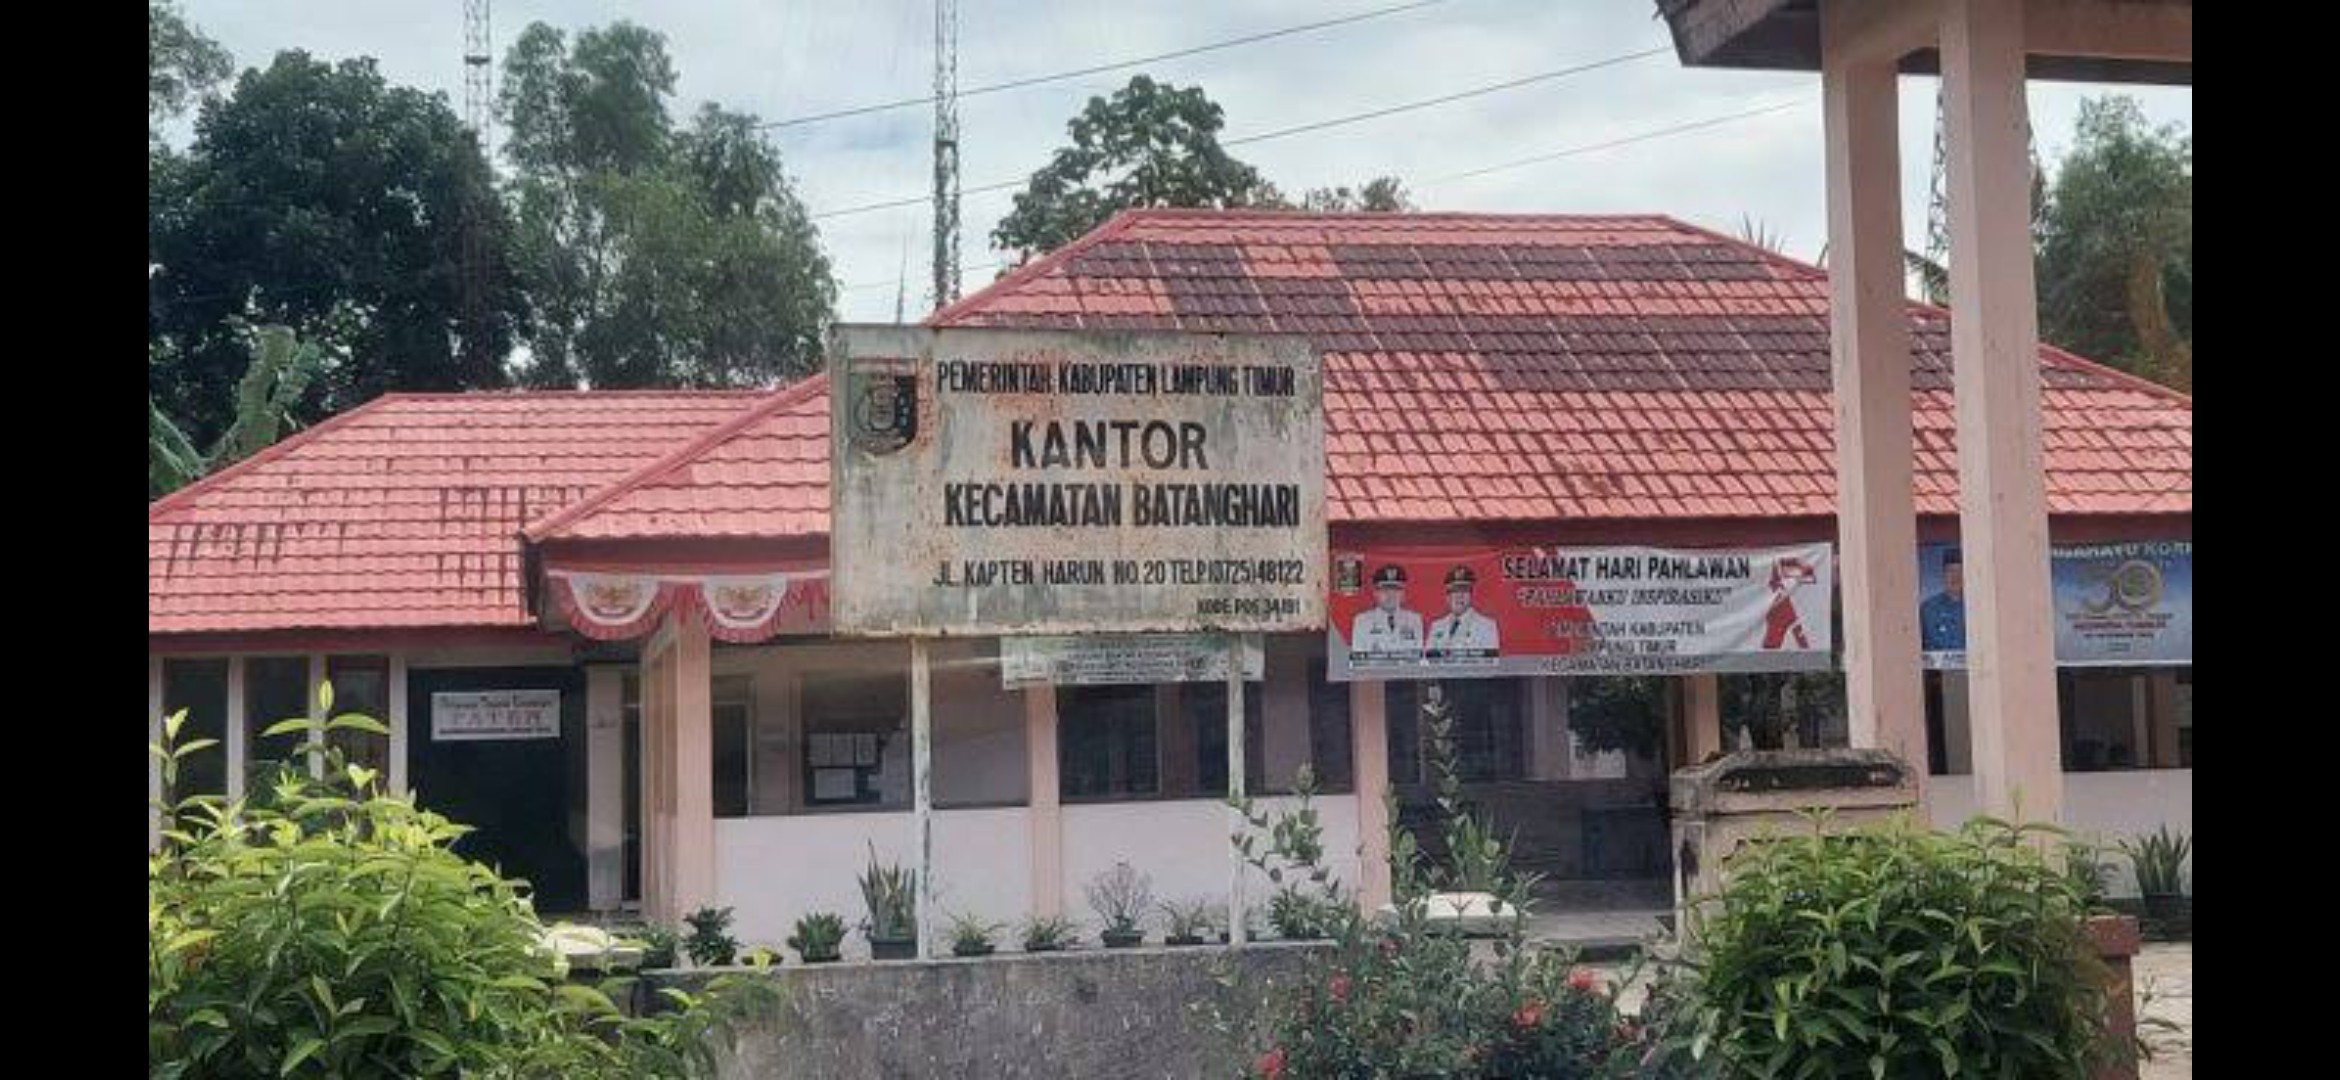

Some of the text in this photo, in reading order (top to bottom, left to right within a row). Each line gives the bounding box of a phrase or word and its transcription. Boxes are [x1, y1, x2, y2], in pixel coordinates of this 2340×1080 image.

[936, 362, 1295, 397] PEMERINTAH KABUPATEN LAMPUNG TIMUR
[1011, 419, 1209, 471] KANTOR
[943, 482, 1301, 528] KECAMATAN BATANGHARI
[965, 559, 1034, 587] KAPTEN
[1043, 560, 1104, 585] HARUN
[1503, 556, 1751, 580] SELAMAT HARI PAHLAWAN
